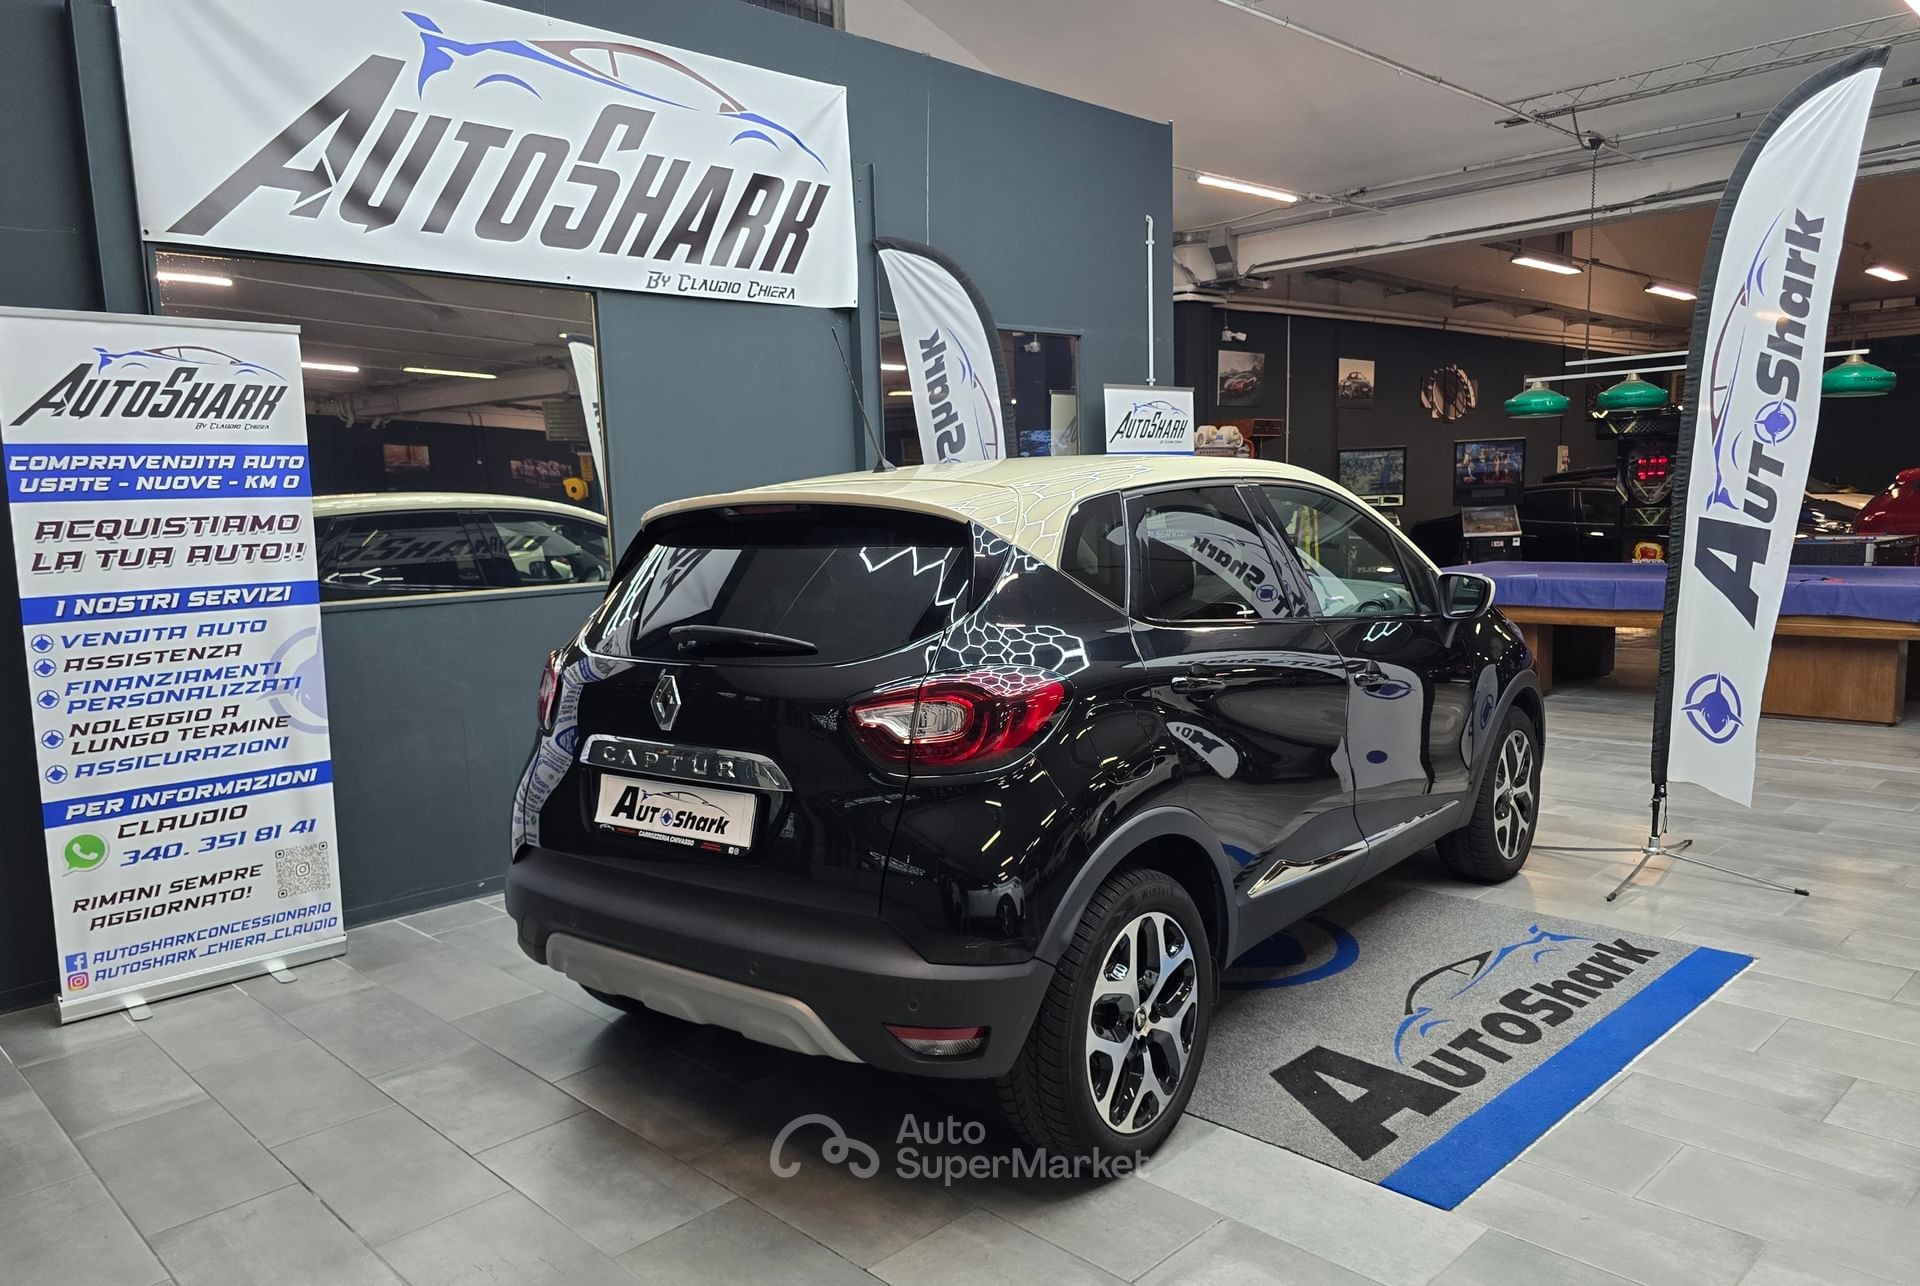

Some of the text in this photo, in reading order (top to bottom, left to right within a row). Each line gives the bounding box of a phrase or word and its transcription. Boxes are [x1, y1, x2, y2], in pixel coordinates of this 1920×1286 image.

[9, 455, 306, 471] COMPRAVENDITA AUTO
[19, 477, 111, 493] USATE
[135, 475, 222, 491] NUOVE
[244, 474, 277, 489] KM
[34, 514, 301, 542] ACQUISTIAMO
[31, 542, 305, 573] LA TUA AUTO!!
[55, 585, 291, 616] I NOSTRI SERVIZI
[60, 619, 267, 649] VENDITA AUTO
[63, 643, 243, 673] ASSISTENZA
[64, 661, 282, 697] FINANZIAMENTI
[66, 675, 303, 714] PERSONALIZZATI
[69, 704, 240, 738] NOLEGGIO A
[70, 715, 291, 755] LUNGO TERMINE
[73, 736, 290, 779] ASSICURAZIONI
[603, 747, 735, 777] CAPTUR
[65, 767, 318, 821] PER INFORMAZIONI
[117, 804, 248, 839] CLAUDIO
[120, 818, 317, 867] 340. 351 81 41
[73, 864, 264, 913] RIMANI SEMPRE
[89, 886, 252, 931] AGGIORNATO!
[92, 902, 332, 964] AUTOSHARKCONCESSIONARIO
